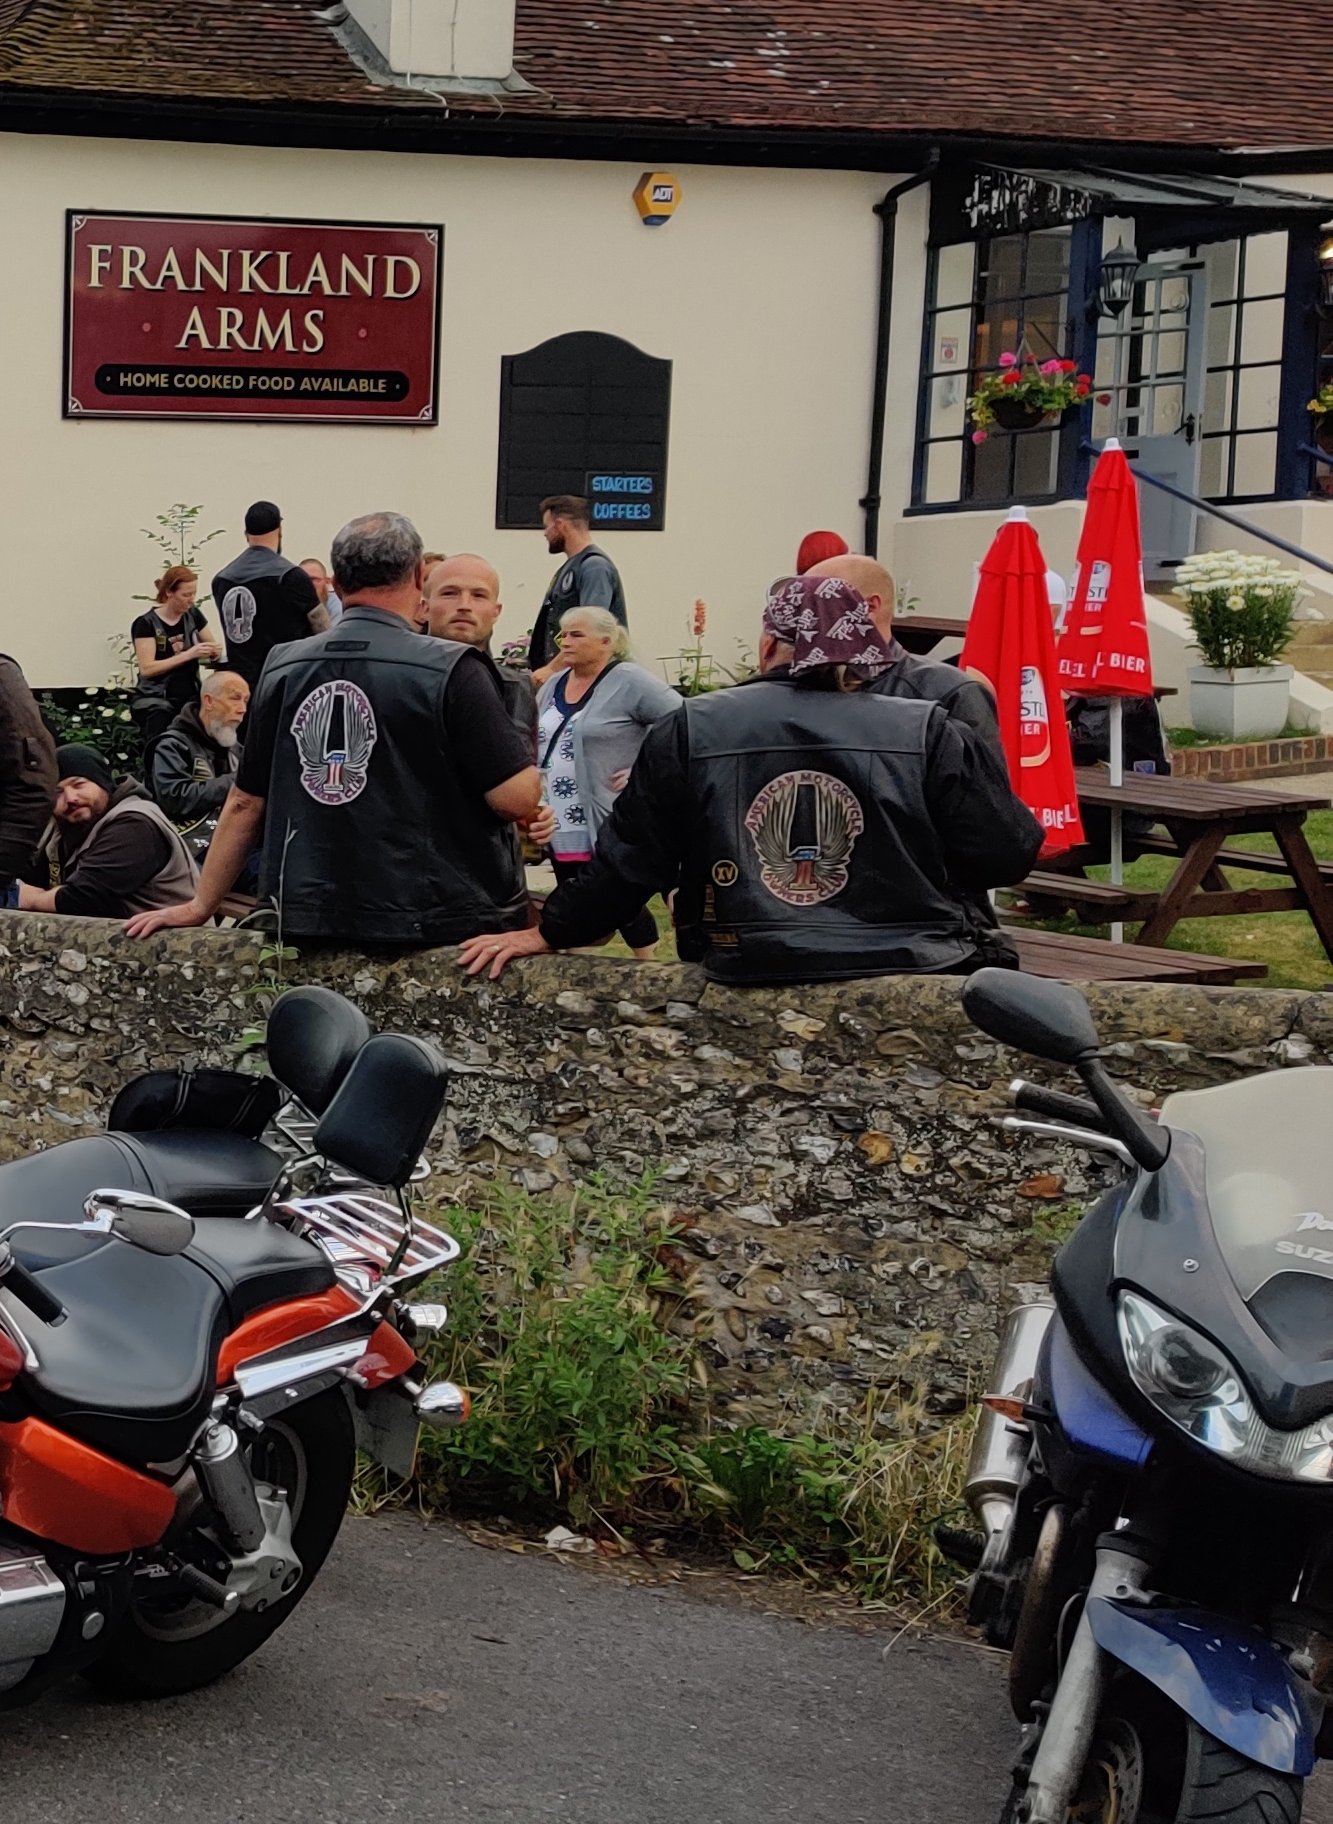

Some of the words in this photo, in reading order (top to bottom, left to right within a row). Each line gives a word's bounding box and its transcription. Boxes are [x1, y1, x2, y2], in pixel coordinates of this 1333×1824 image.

[653, 187, 673, 200] ADT
[86, 244, 421, 299] FRANKLAND
[174, 305, 325, 353] ARMS
[119, 372, 169, 388] HOME
[173, 374, 244, 390] COOKED
[248, 375, 296, 391] FOOD
[299, 377, 387, 393] AVAILABLE
[592, 476, 653, 494] STARTERS
[594, 502, 651, 519] COFFEES
[1110, 653, 1145, 673] BIER
[746, 774, 795, 833] AMERICAN
[800, 773, 862, 833] MOTORCYCLE
[716, 866, 733, 881] XV
[763, 873, 815, 903] OWNERS
[1274, 1241, 1333, 1265] SUZ
